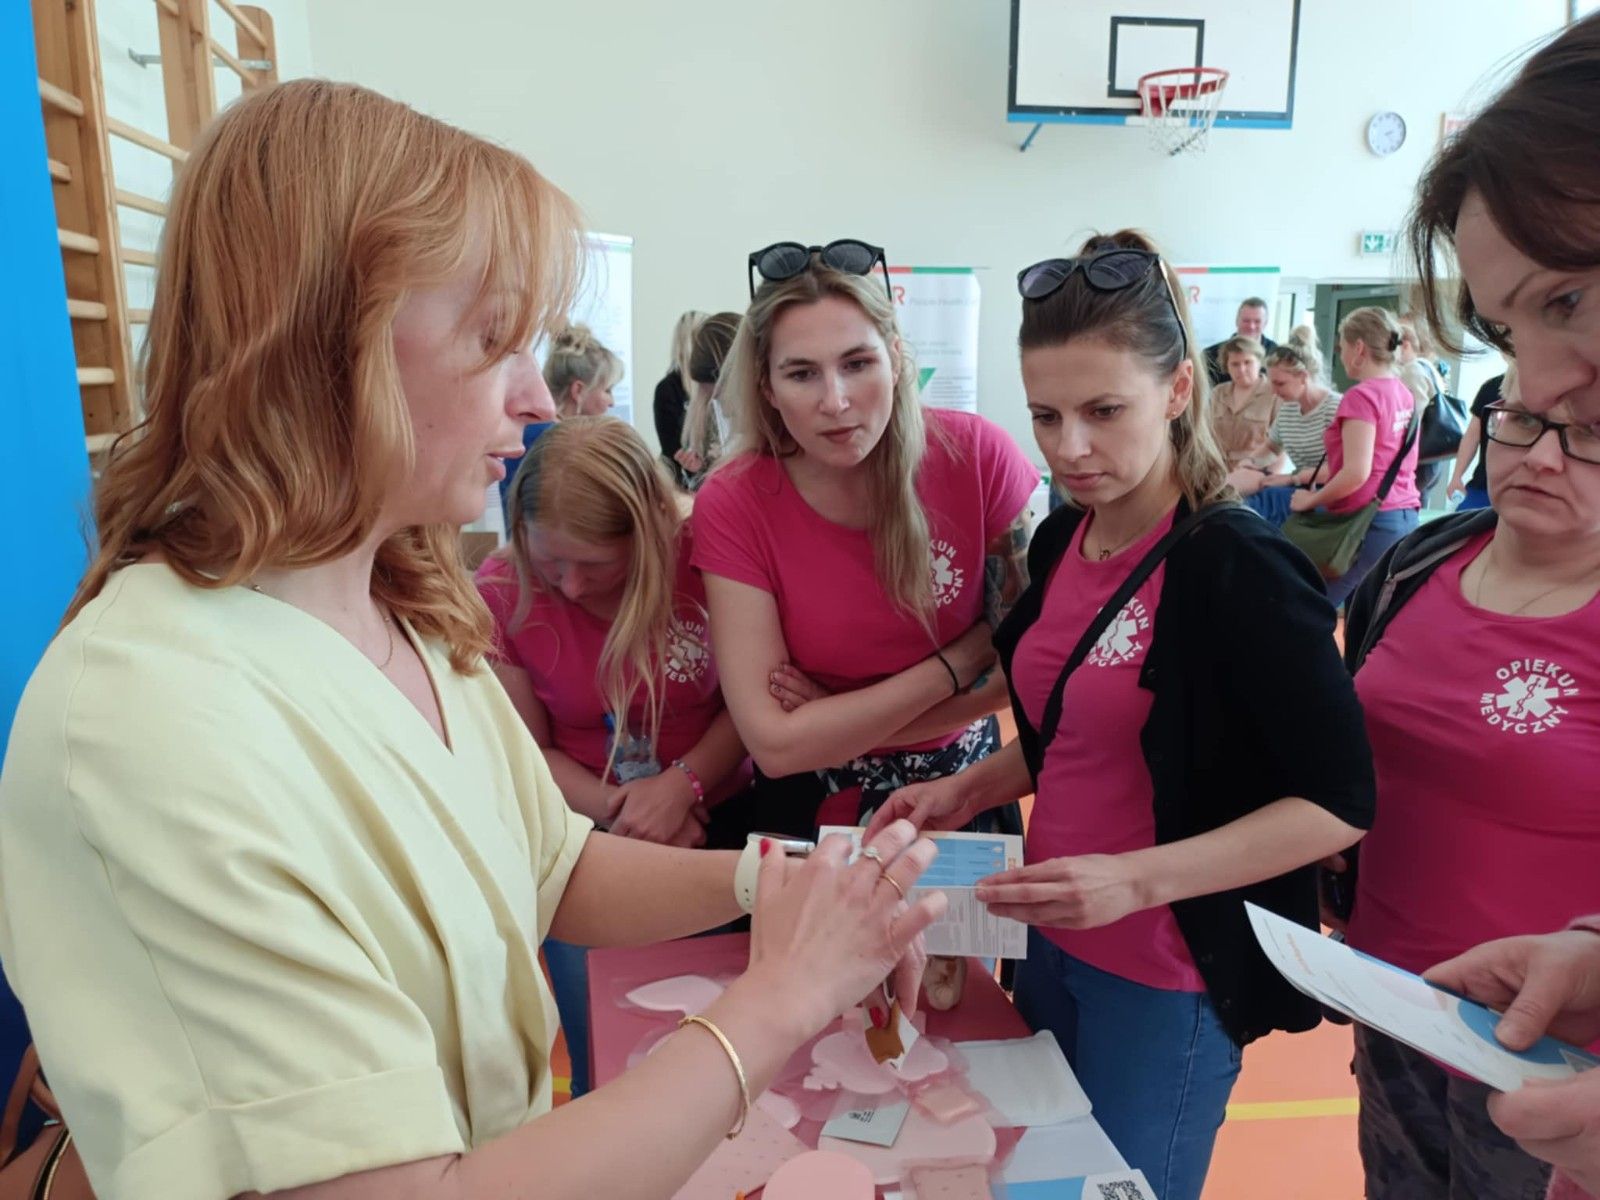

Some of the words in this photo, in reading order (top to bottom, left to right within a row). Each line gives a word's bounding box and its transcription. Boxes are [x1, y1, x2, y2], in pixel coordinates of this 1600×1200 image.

[892, 286, 906, 305] R
[934, 568, 964, 609] YCZNY
[1496, 658, 1580, 697] OPIEKUN
[1480, 692, 1569, 735] MEDYCZNY
